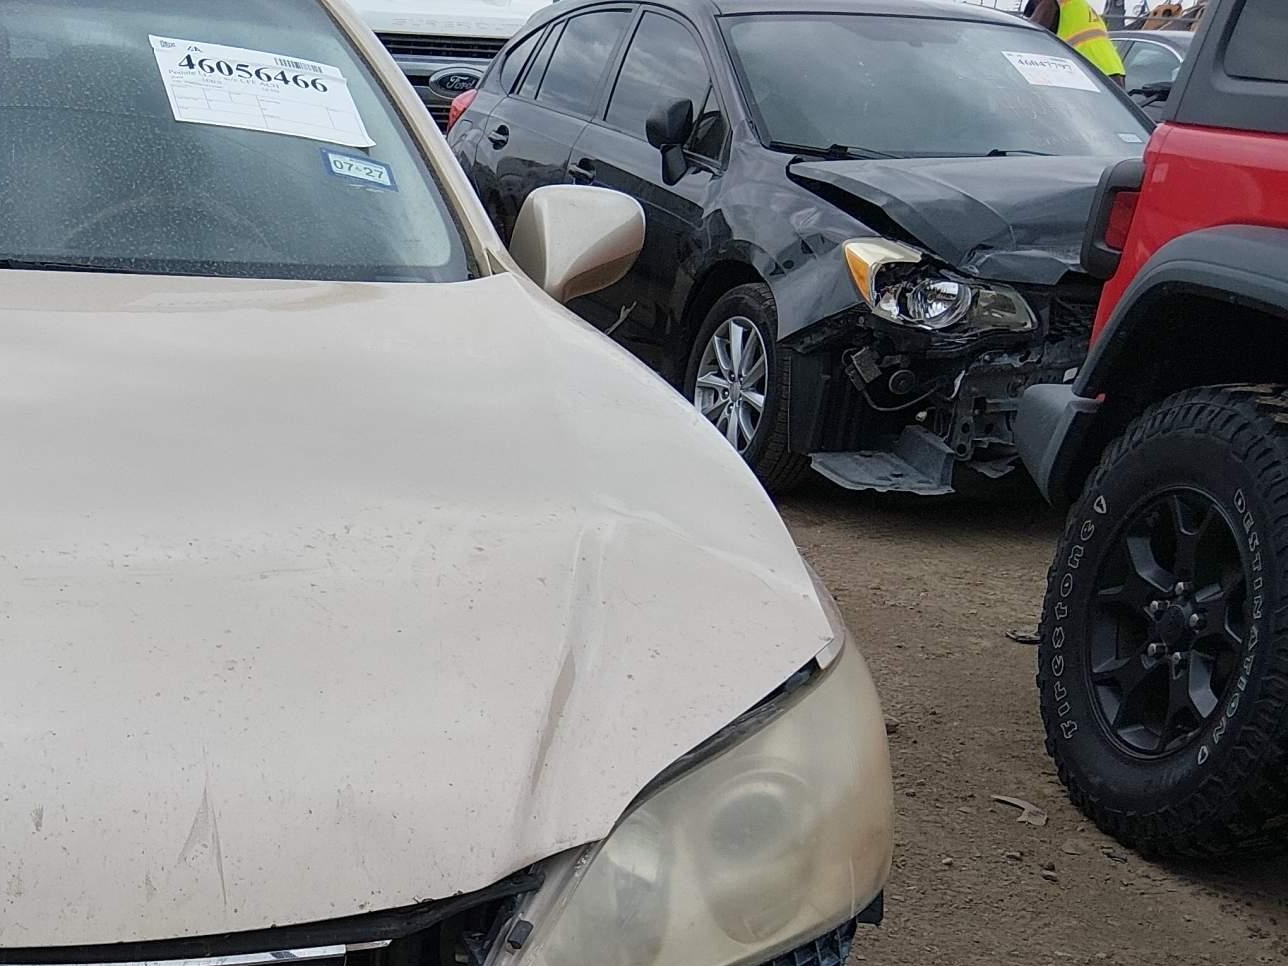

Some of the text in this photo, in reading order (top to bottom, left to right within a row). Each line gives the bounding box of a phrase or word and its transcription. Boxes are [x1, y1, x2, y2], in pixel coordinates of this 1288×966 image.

[178, 54, 329, 93] 46056466
[447, 75, 477, 91] Ford
[332, 159, 384, 179] 07-27
